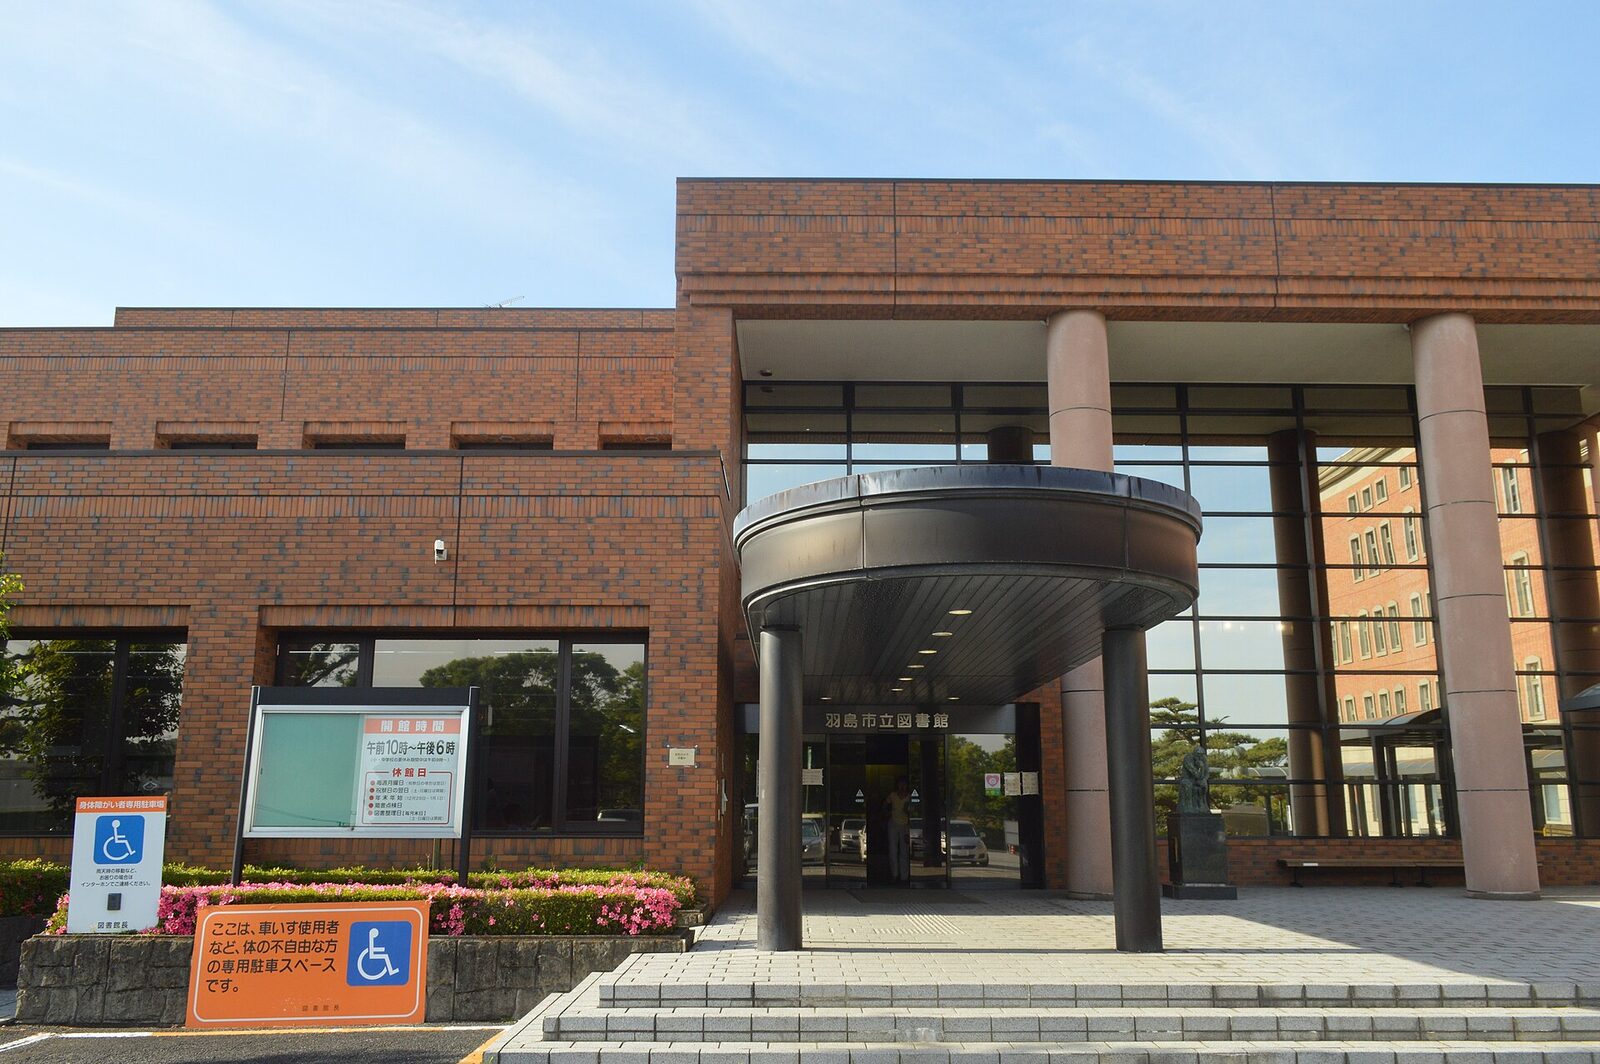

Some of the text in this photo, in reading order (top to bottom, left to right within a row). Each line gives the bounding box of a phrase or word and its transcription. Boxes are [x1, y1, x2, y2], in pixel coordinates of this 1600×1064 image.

[381, 719, 445, 732] 開館時間
[825, 712, 949, 728] 羽島市立図書館
[367, 739, 455, 755] 午前10時～午後6時
[392, 767, 427, 777] 休館日
[79, 800, 164, 809] 身体障がい者専用駐車場
[97, 921, 129, 929] 図書館長
[211, 920, 339, 936] ここは、車いす使用者
[208, 939, 338, 955] など、体の不自由な方
[207, 957, 337, 974] の専用駐車スペース
[206, 978, 239, 993] です。
